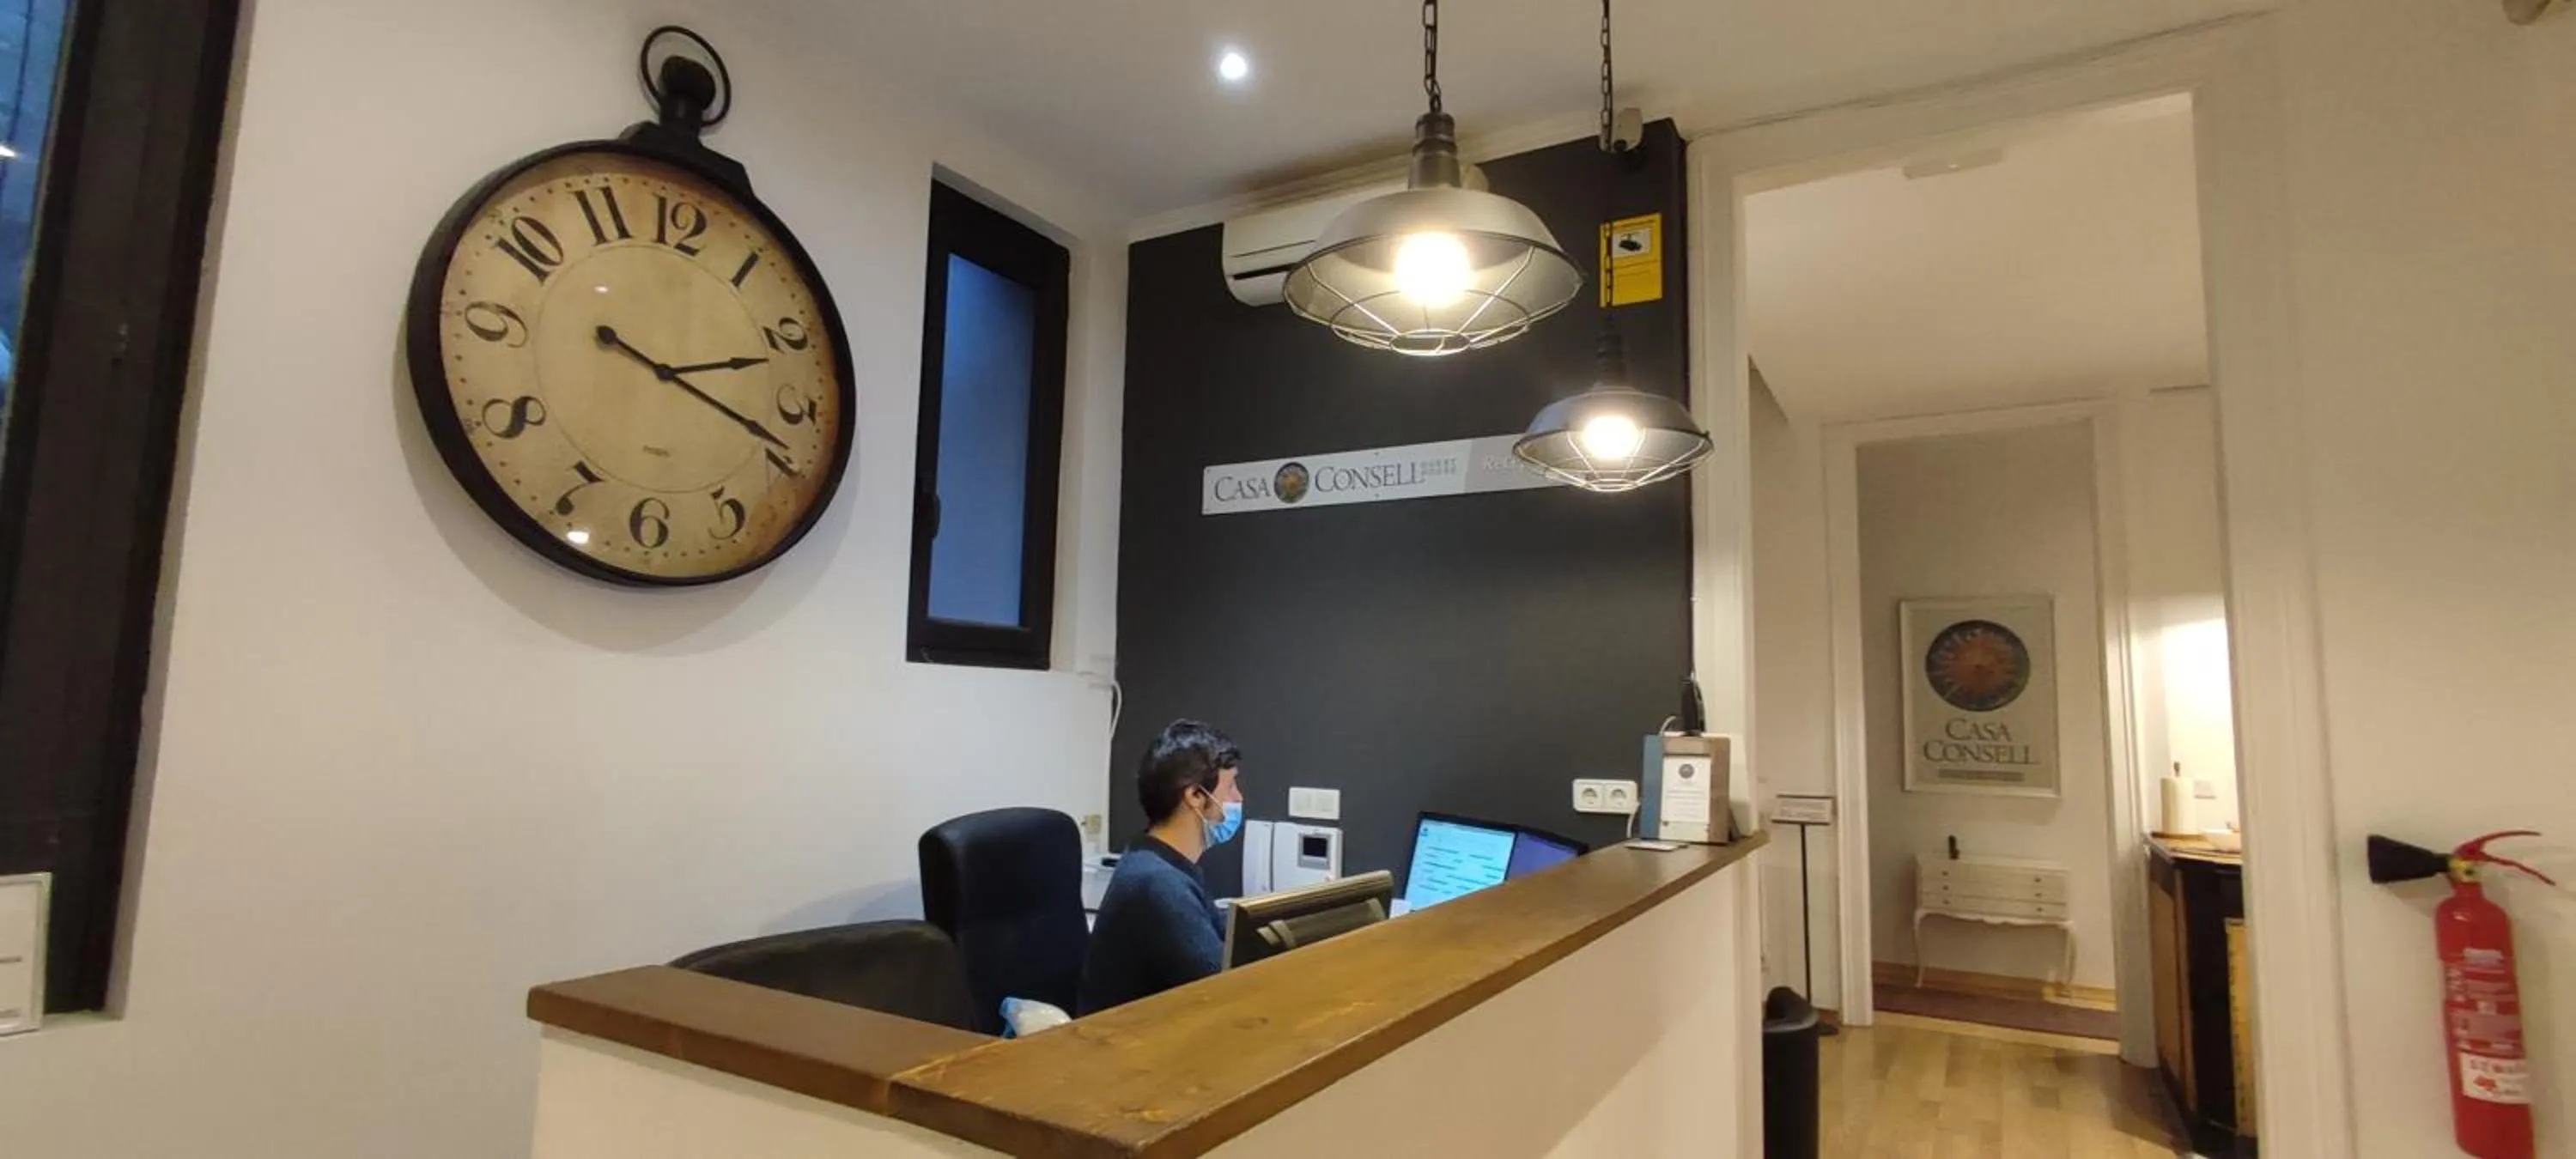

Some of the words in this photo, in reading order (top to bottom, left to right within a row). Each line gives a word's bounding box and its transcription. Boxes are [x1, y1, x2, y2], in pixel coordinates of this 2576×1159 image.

[571, 185, 635, 246] 11
[652, 190, 708, 257] 12
[493, 215, 565, 286] 10
[731, 247, 763, 289] 1
[464, 300, 528, 349] 9
[763, 316, 809, 355] 2
[481, 395, 547, 439] 8
[775, 383, 817, 427] 3
[555, 460, 605, 516] 7
[1214, 476, 1272, 501] CASA
[1315, 462, 1426, 492] CONSELL
[629, 496, 671, 549] 6
[708, 484, 747, 541] 5
[1923, 739, 2041, 765] CONSELL
[1945, 718, 2013, 742] CASA
